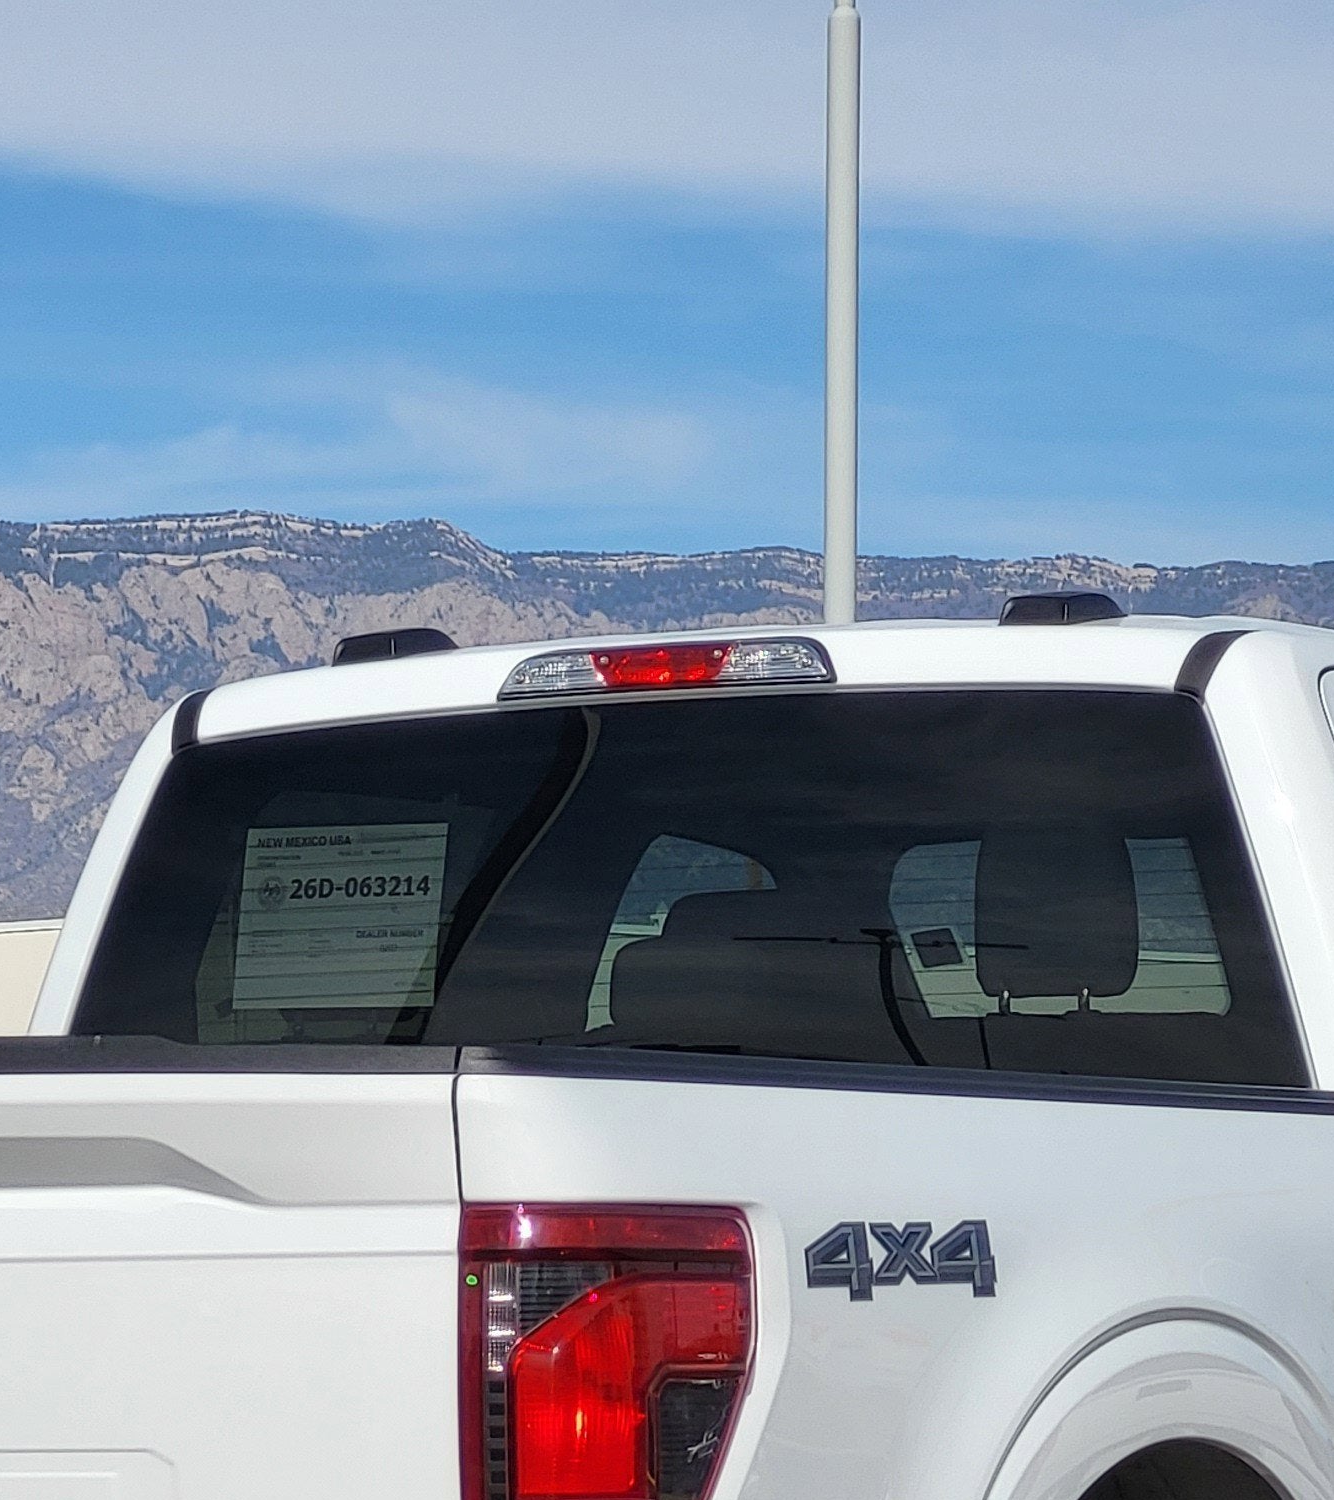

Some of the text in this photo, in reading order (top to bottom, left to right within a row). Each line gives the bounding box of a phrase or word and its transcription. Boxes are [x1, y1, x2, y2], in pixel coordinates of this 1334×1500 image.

[257, 837, 283, 848] NEW
[285, 835, 327, 848] MEXICO
[329, 834, 352, 846] USA
[289, 875, 431, 900] 26D-063214
